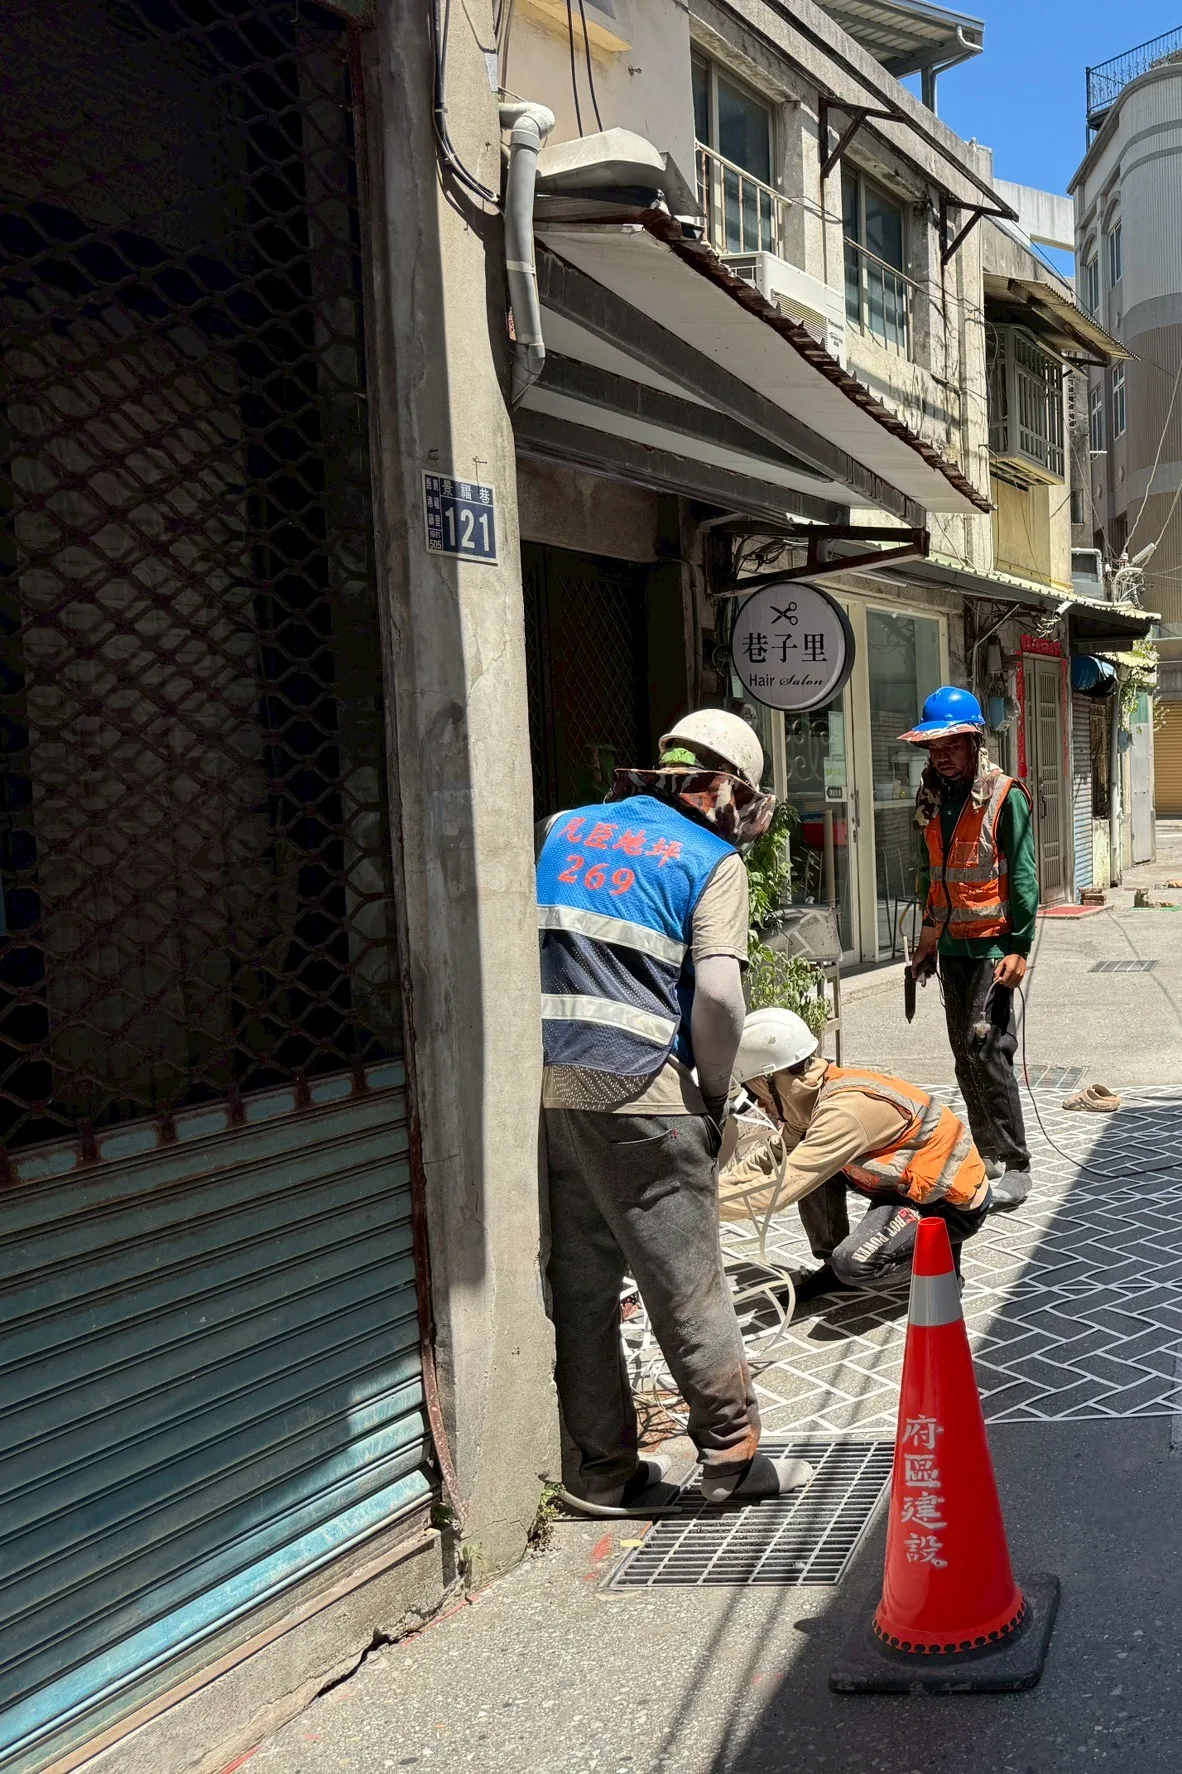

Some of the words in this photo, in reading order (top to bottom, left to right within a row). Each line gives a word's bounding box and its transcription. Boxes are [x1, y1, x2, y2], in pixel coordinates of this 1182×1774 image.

[441, 479, 490, 504] 景福巷
[445, 506, 490, 552] 121
[429, 540, 442, 550] 505
[742, 632, 828, 663] 巷子里
[749, 673, 775, 687] Hair
[779, 674, 823, 686] Salon
[557, 853, 636, 896] 269
[851, 1231, 890, 1263] POWER
[901, 1413, 949, 1569] 府區建設
